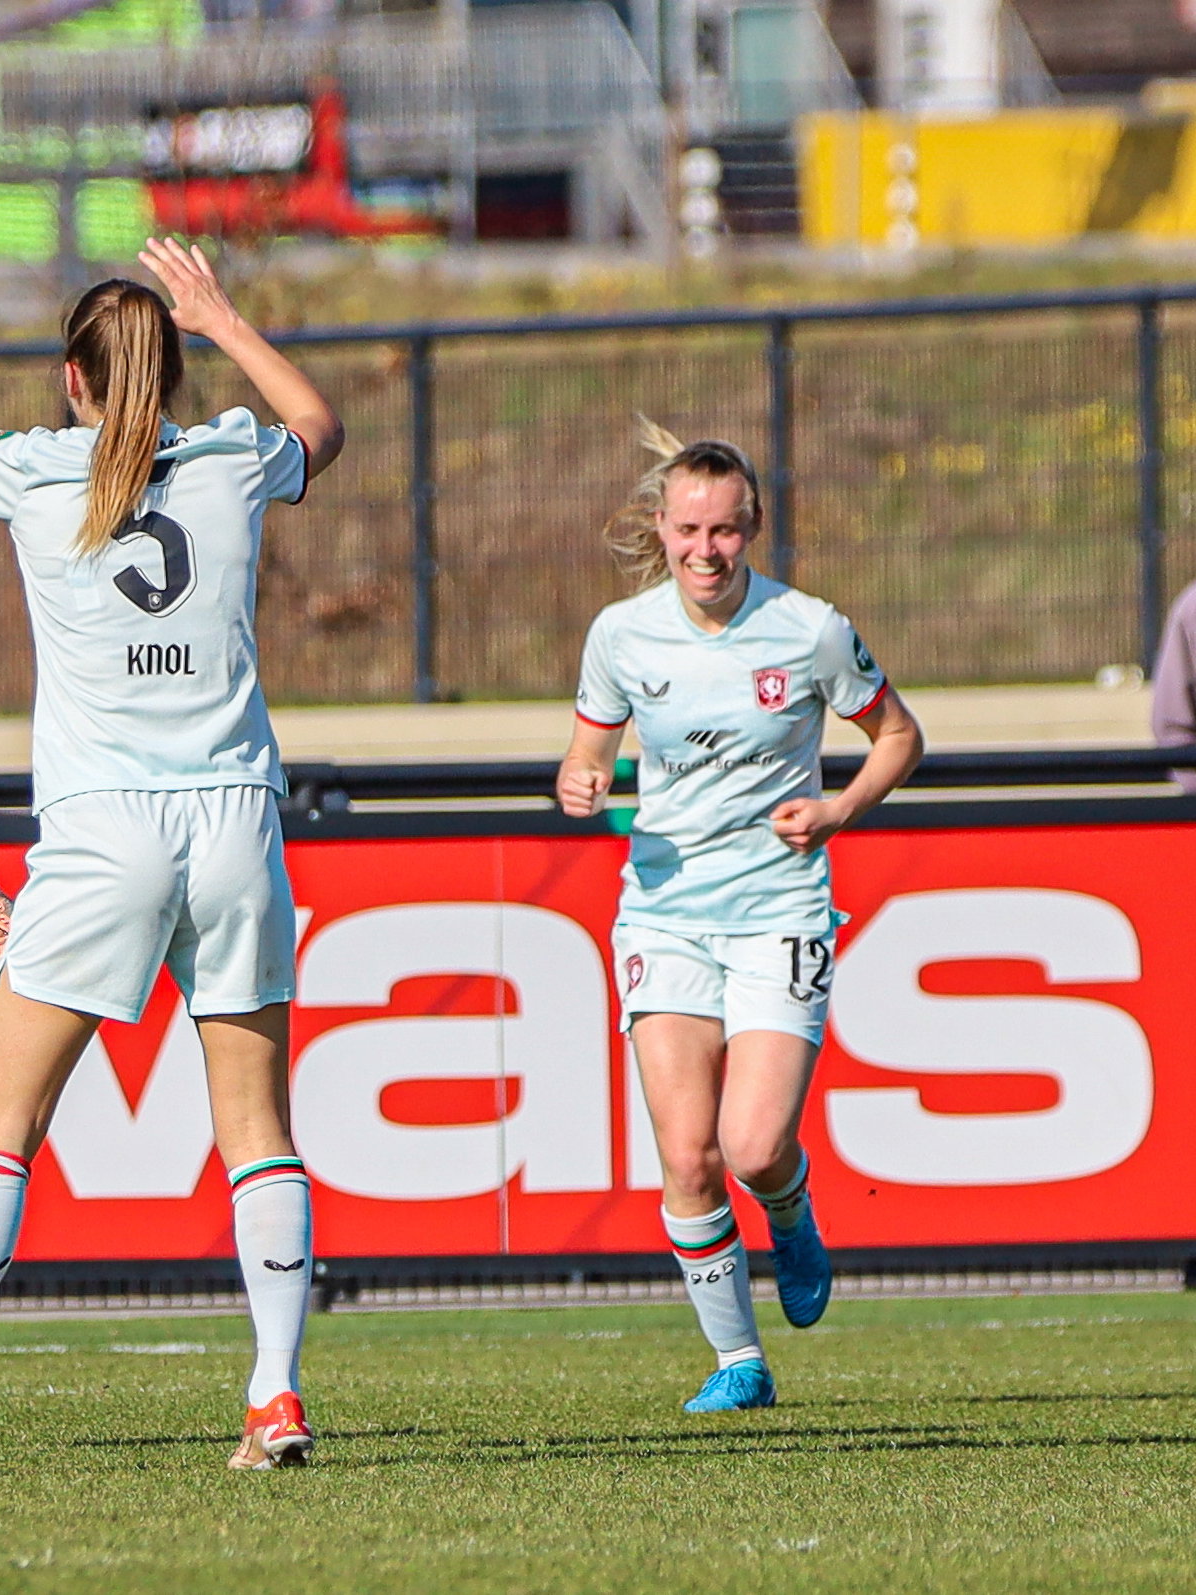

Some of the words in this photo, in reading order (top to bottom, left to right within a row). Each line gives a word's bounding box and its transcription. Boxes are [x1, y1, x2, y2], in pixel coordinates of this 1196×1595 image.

[126, 643, 196, 676] KNOL
[781, 935, 831, 994] 12
[684, 1258, 737, 1285] 965
